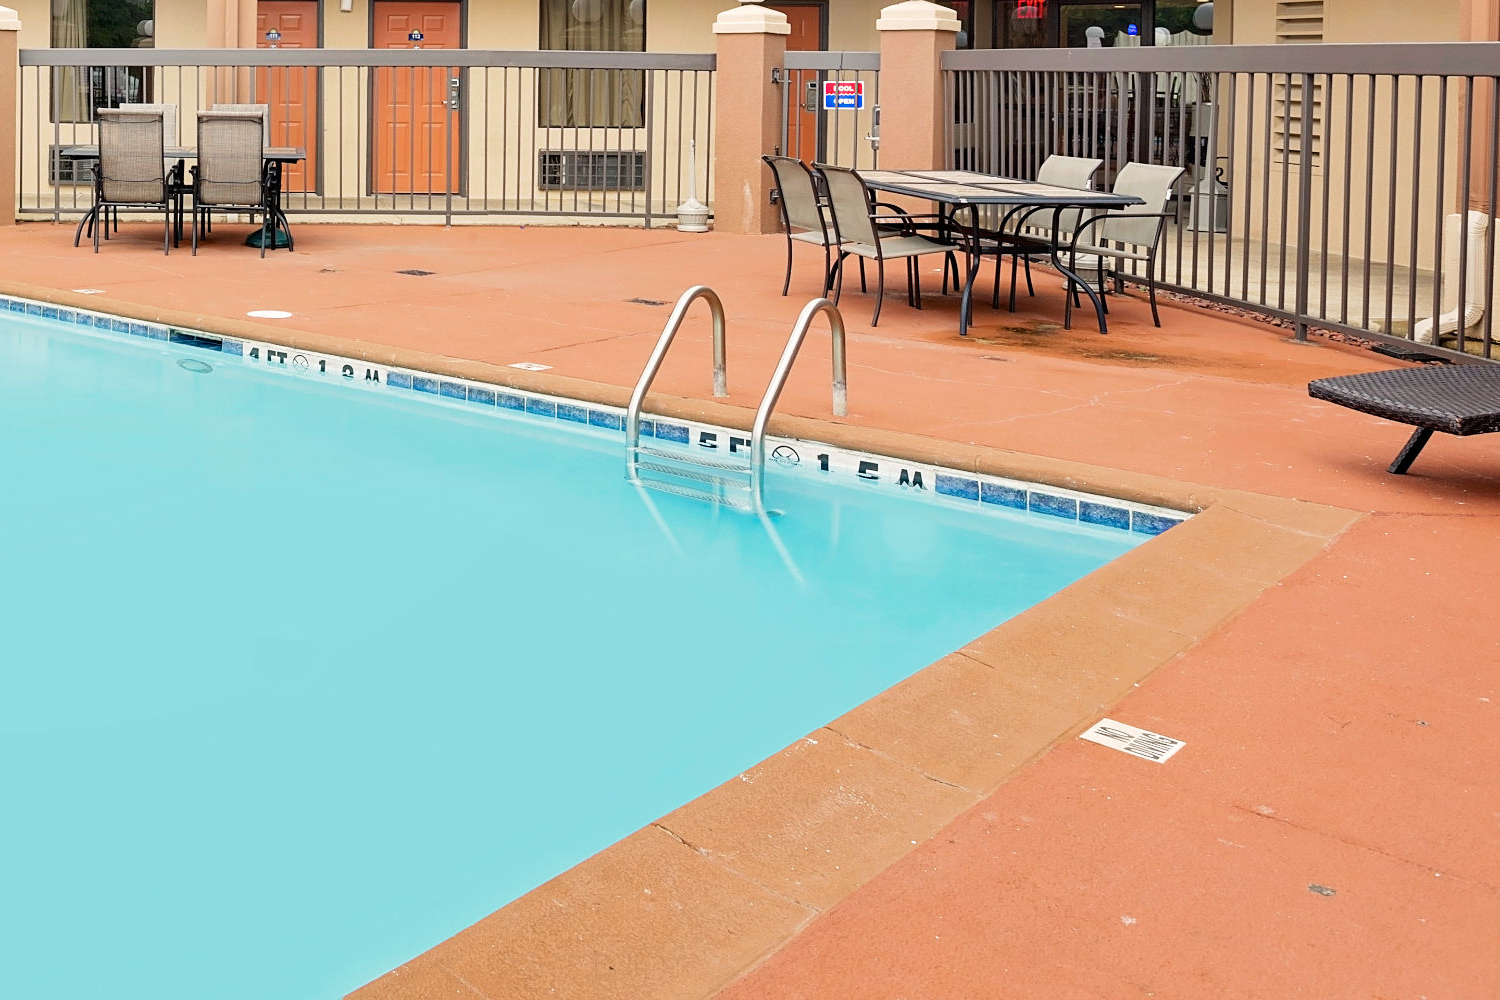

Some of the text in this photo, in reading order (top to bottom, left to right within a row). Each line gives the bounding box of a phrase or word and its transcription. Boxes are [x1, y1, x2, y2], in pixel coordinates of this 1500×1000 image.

[1017, 0, 1045, 19] EXIT
[1094, 726, 1136, 743] NO
[1123, 732, 1179, 760] DIVING
